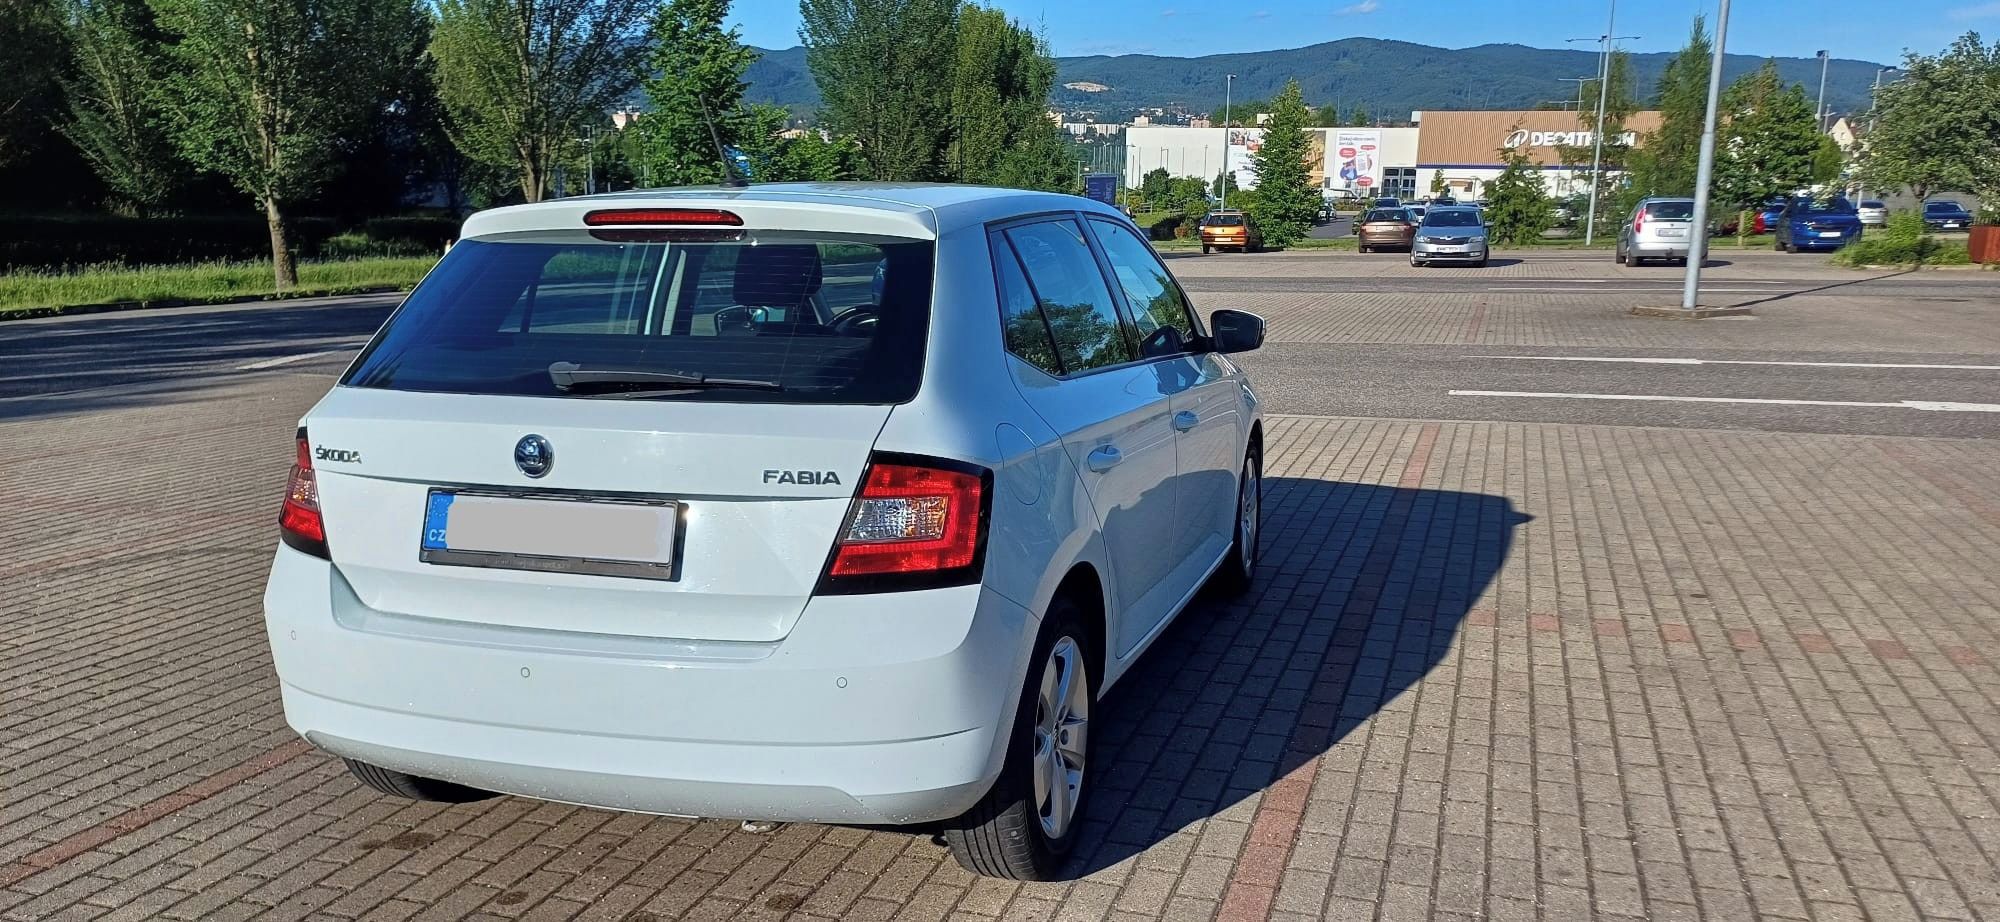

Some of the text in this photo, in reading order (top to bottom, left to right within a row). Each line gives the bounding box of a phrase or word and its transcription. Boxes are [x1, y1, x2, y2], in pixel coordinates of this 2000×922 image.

[1529, 131, 1636, 147] DECATHON
[762, 469, 842, 485] FABIA
[428, 528, 446, 542] CZ
